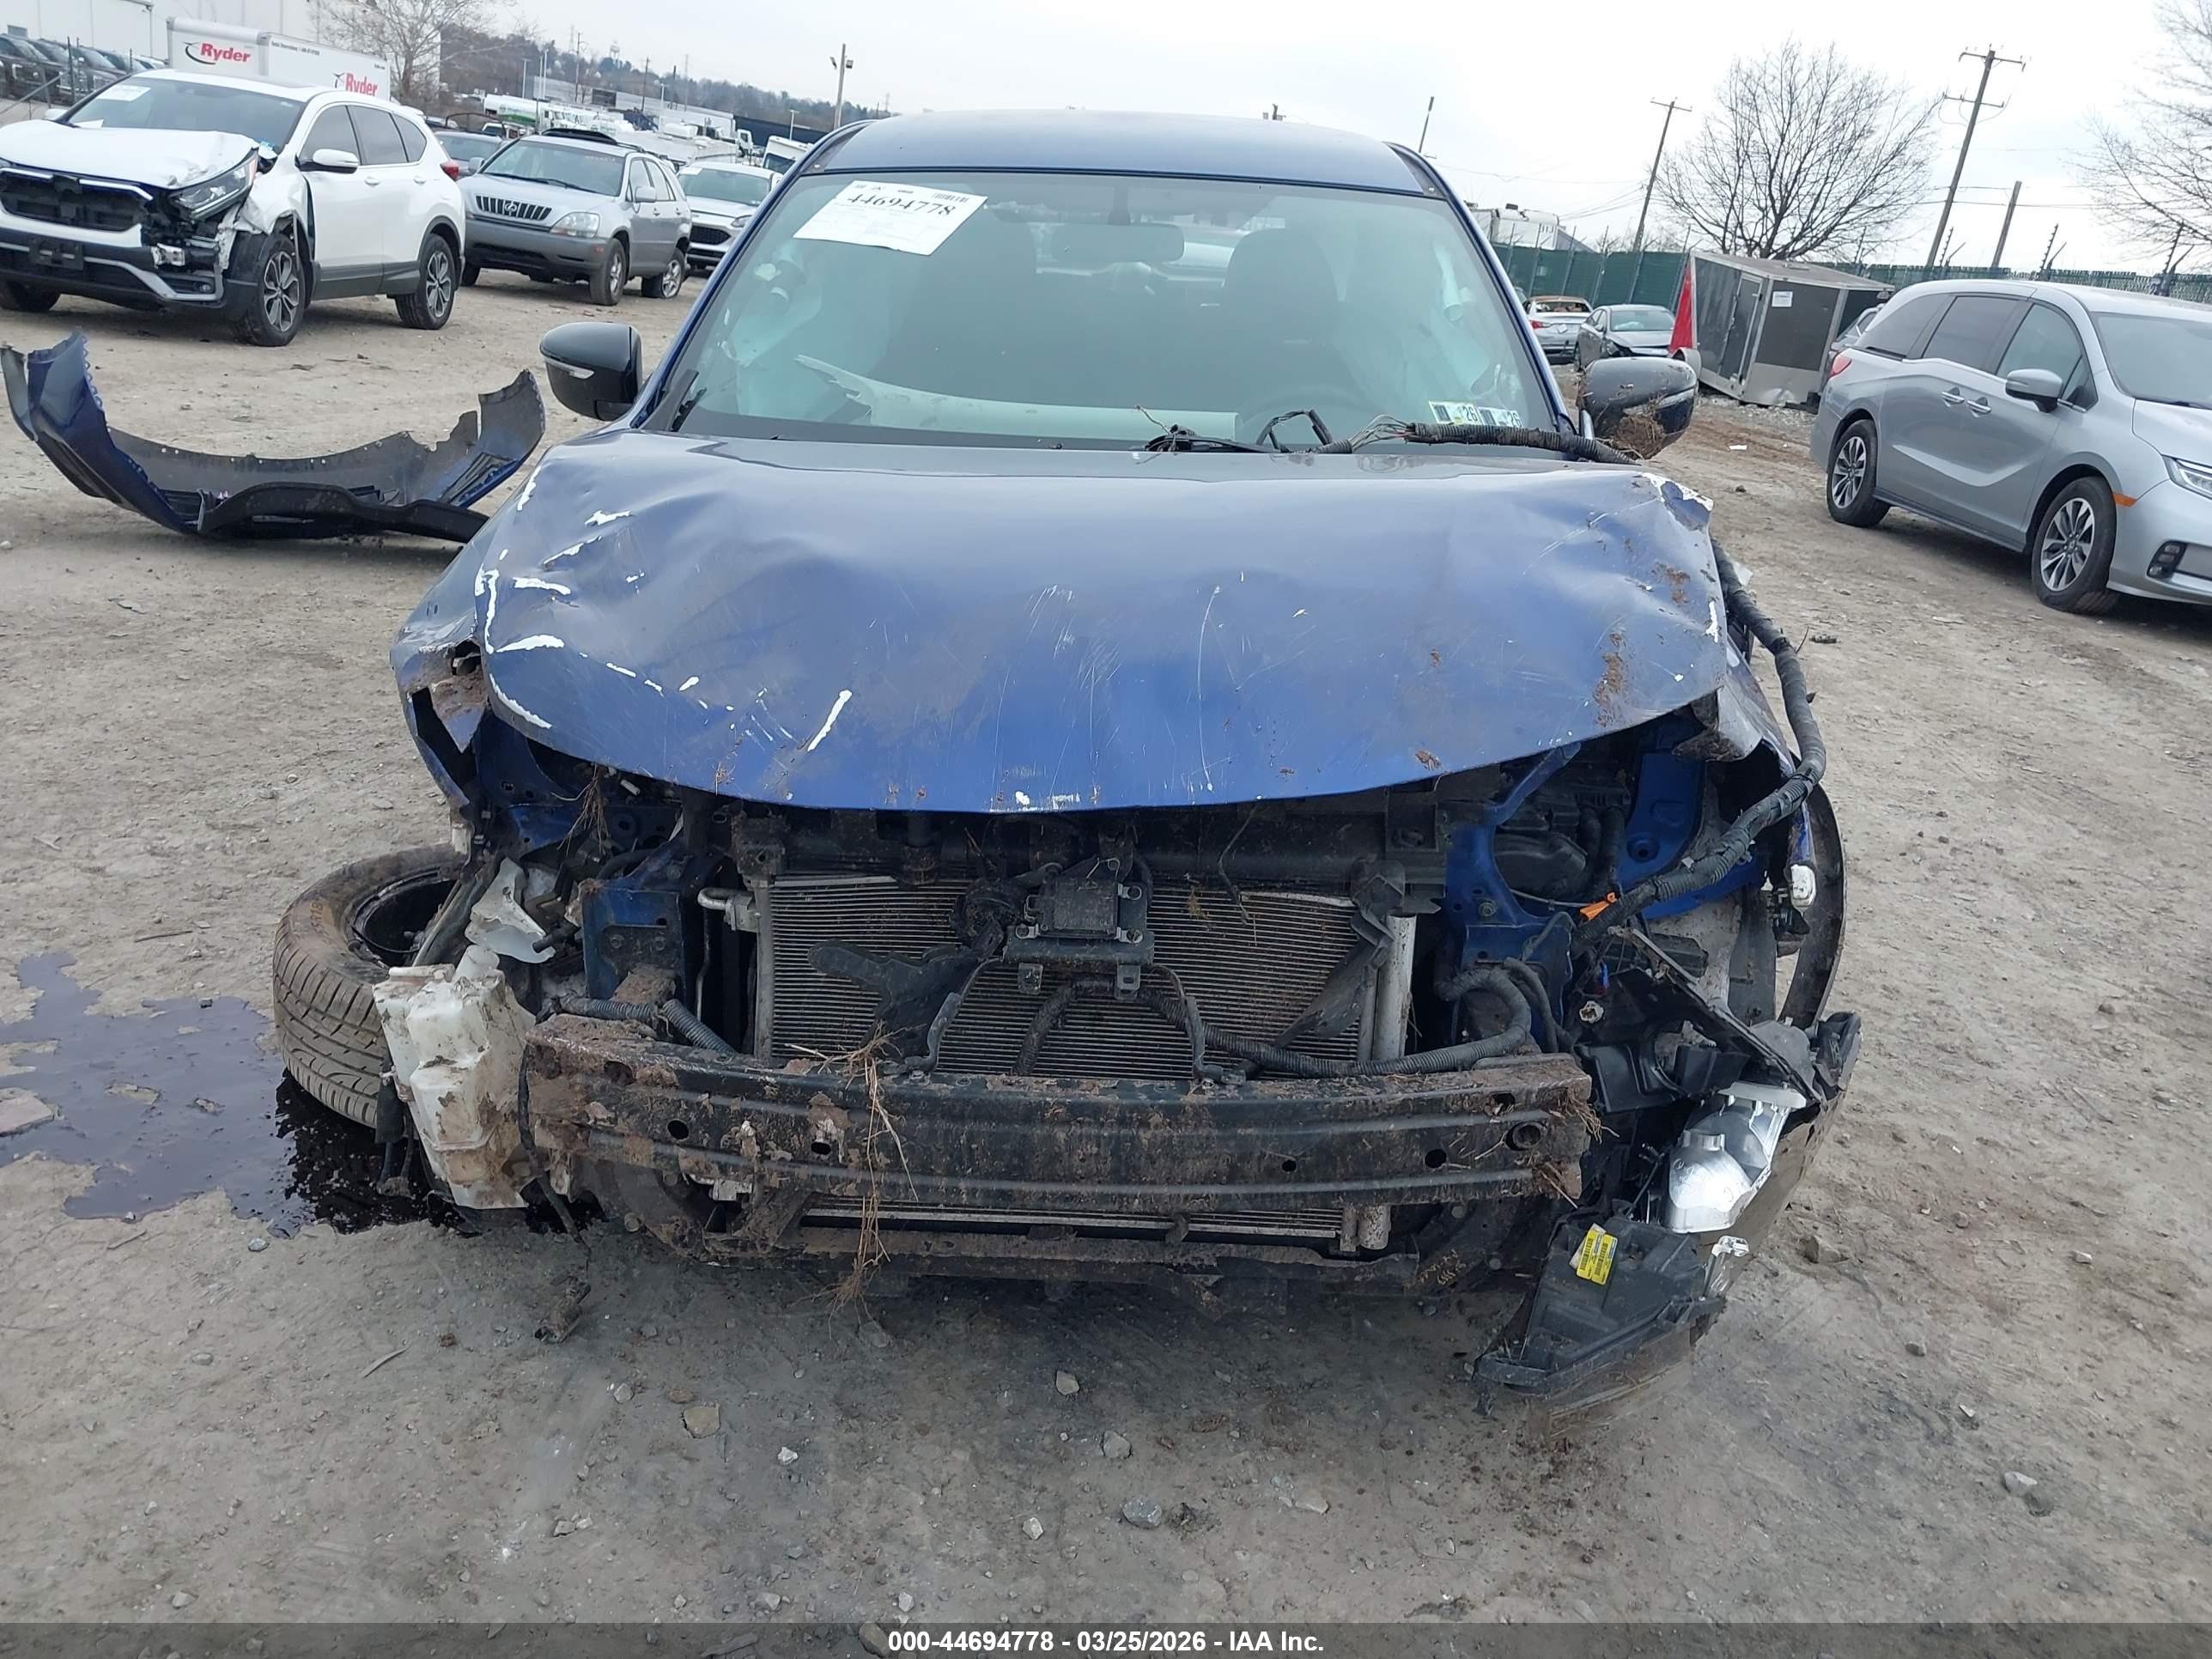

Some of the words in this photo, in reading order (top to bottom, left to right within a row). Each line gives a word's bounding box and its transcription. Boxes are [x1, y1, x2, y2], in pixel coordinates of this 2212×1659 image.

[200, 42, 251, 62] Ryder
[345, 72, 378, 96] Ryder
[848, 193, 956, 216] 44694778
[1463, 405, 1478, 421] 26
